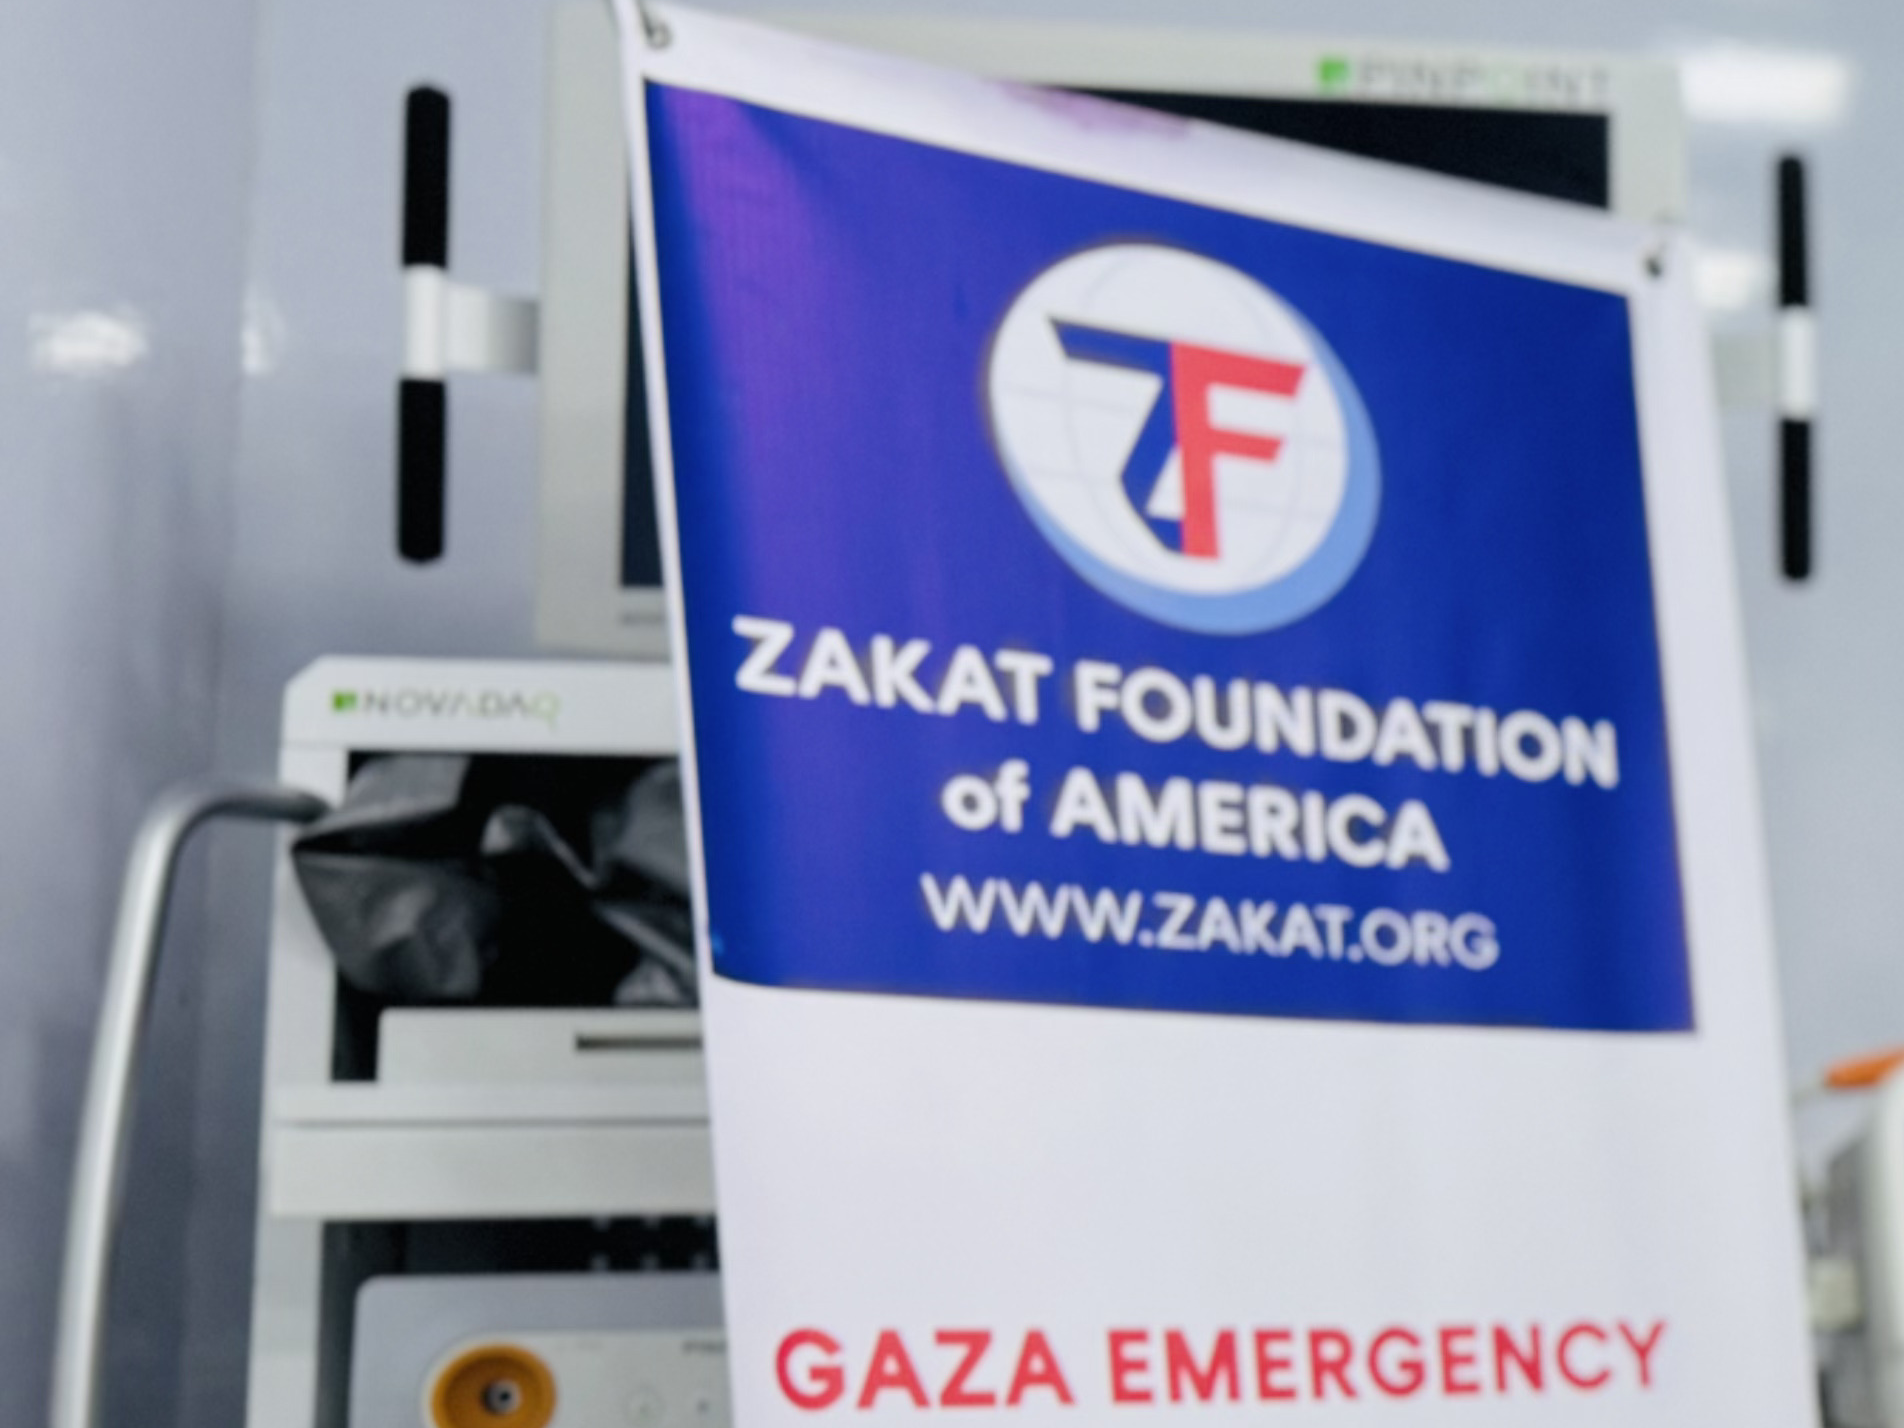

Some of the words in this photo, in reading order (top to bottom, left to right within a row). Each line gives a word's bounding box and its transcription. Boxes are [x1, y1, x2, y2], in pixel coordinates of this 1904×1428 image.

[731, 614, 1055, 726] ZAKAT
[1073, 659, 1618, 788] FOUNDATION
[940, 758, 1031, 834] of
[1049, 766, 1450, 872] AMERICA
[920, 873, 1499, 970] WWW.ZAKAT.ORG
[774, 1326, 1076, 1414] GAZA
[1106, 1320, 1669, 1406] EMERGENCY
